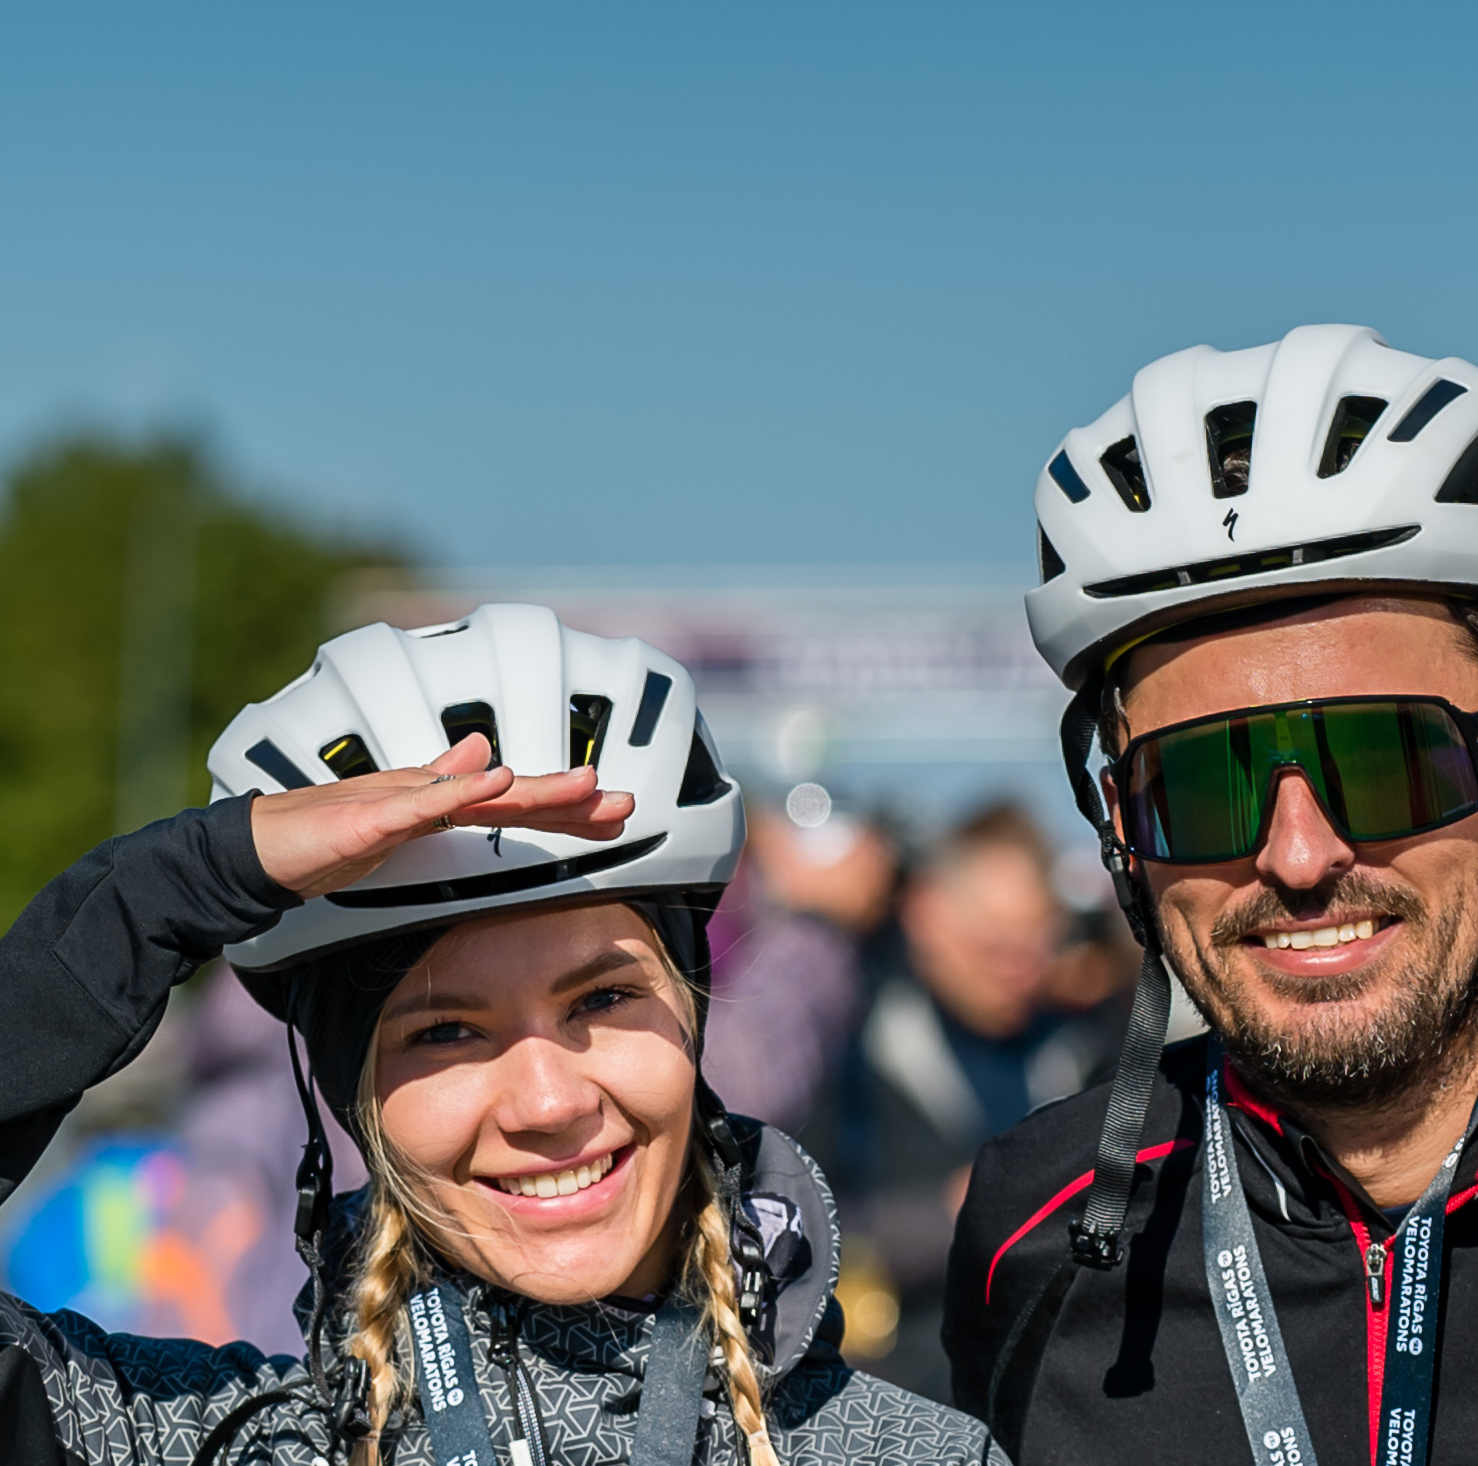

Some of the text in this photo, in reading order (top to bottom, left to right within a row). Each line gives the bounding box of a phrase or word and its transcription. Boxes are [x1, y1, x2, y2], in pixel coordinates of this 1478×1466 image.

[1211, 1069, 1232, 1198] VELOMARATONS
[1207, 1140, 1221, 1204] TOYOTA
[1415, 1217, 1432, 1281] TOYOTA
[426, 1287, 449, 1344] TOYOTA
[1222, 1268, 1245, 1319] RĪGAS
[1233, 1244, 1276, 1377] VELOMARATONS
[1396, 1215, 1420, 1352] VELOMARATONS
[1411, 1283, 1428, 1335] RĪGAS
[410, 1293, 447, 1412] VELOMARATONS
[437, 1342, 459, 1389] RĪGAS
[1235, 1317, 1262, 1383] TOYOTA
